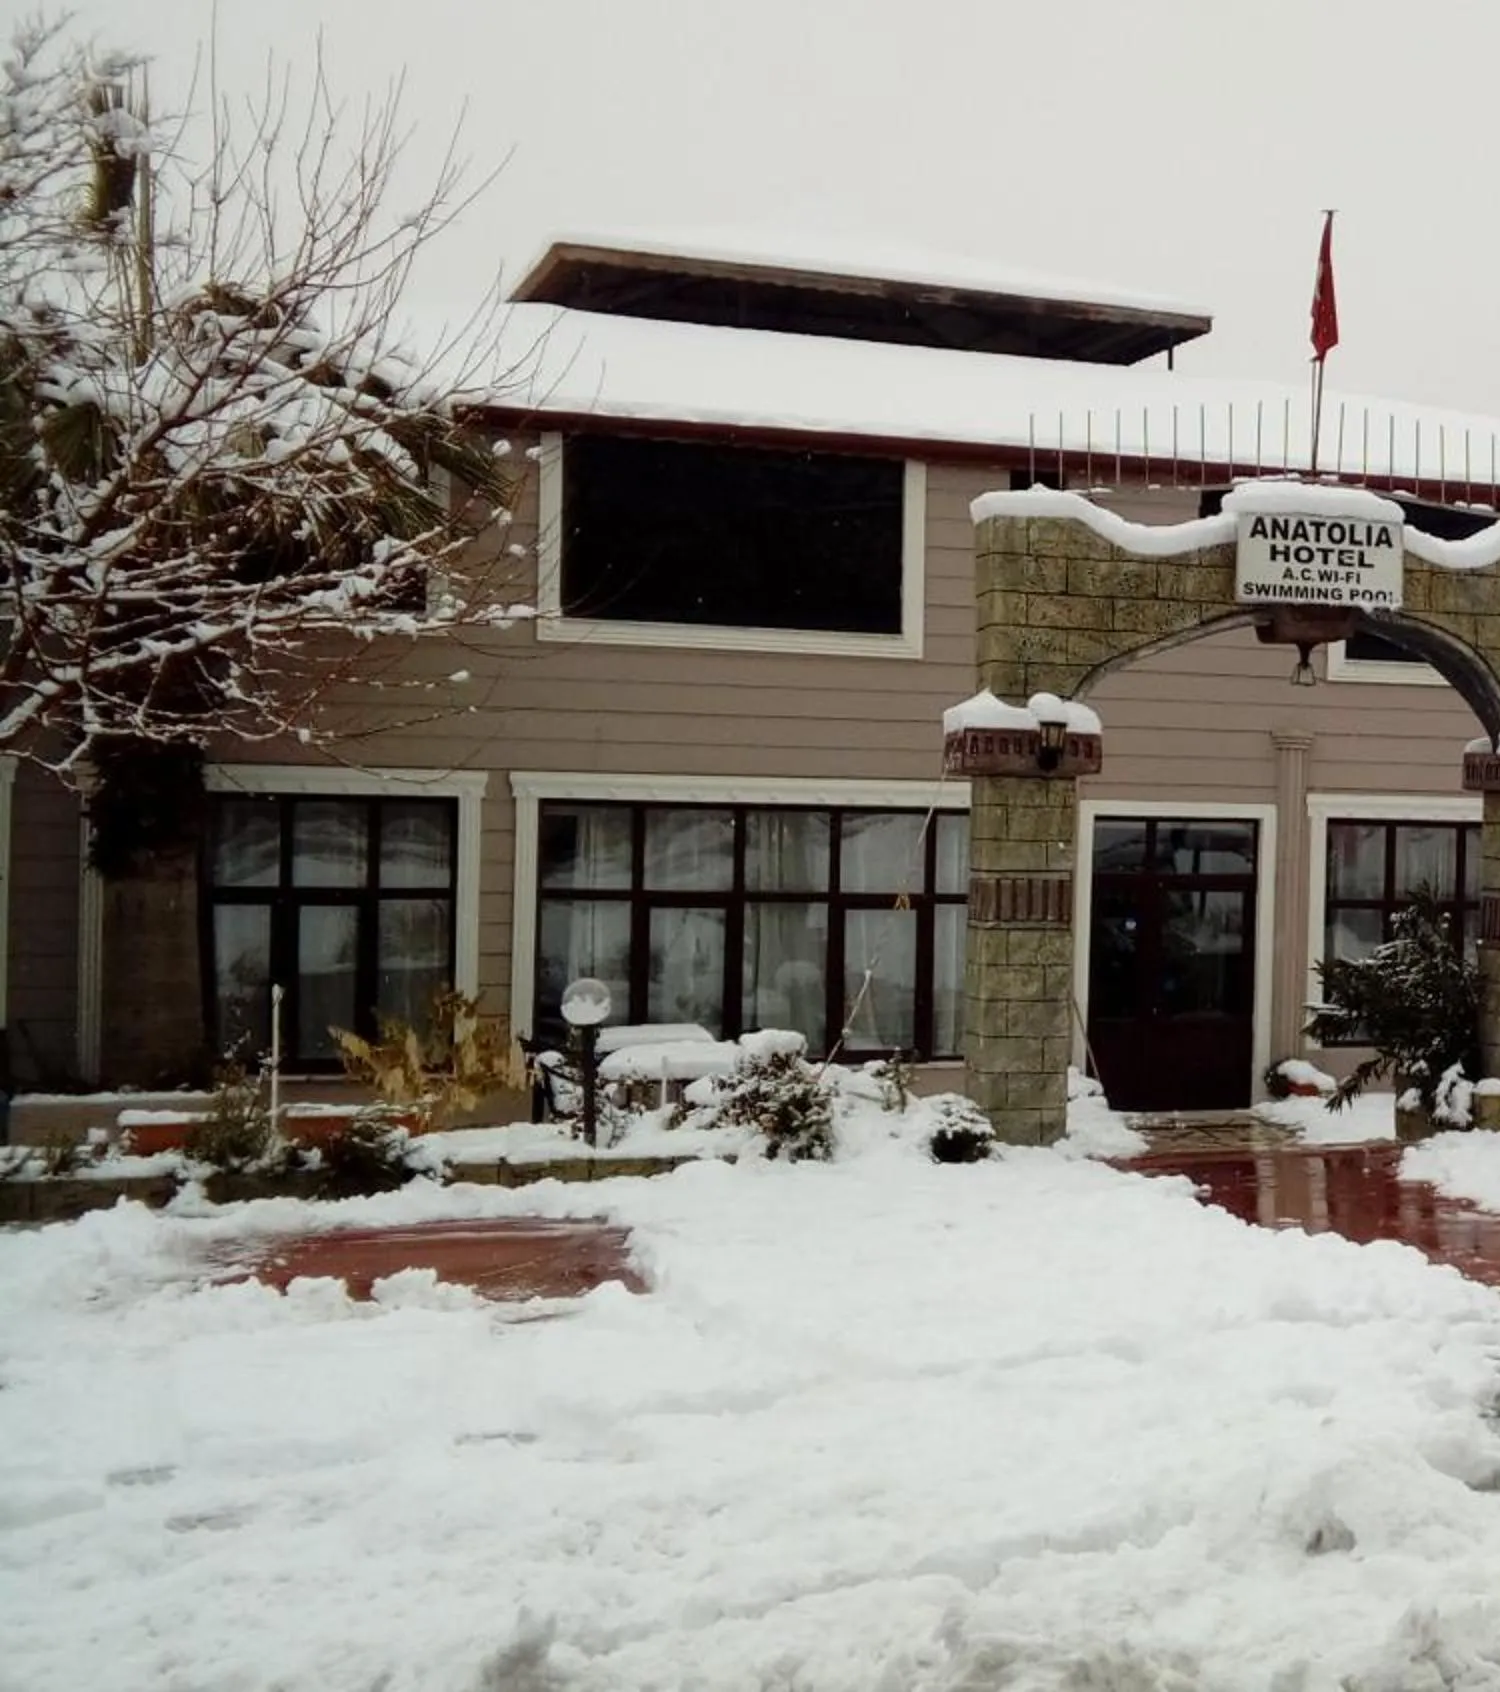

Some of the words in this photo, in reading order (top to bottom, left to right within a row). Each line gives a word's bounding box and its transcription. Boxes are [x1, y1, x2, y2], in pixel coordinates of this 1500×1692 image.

[1250, 516, 1393, 548] ANATOLIA
[1270, 544, 1375, 568] HOTEL
[1318, 569, 1361, 584] WI-FI
[1243, 582, 1343, 601] SWIMMING
